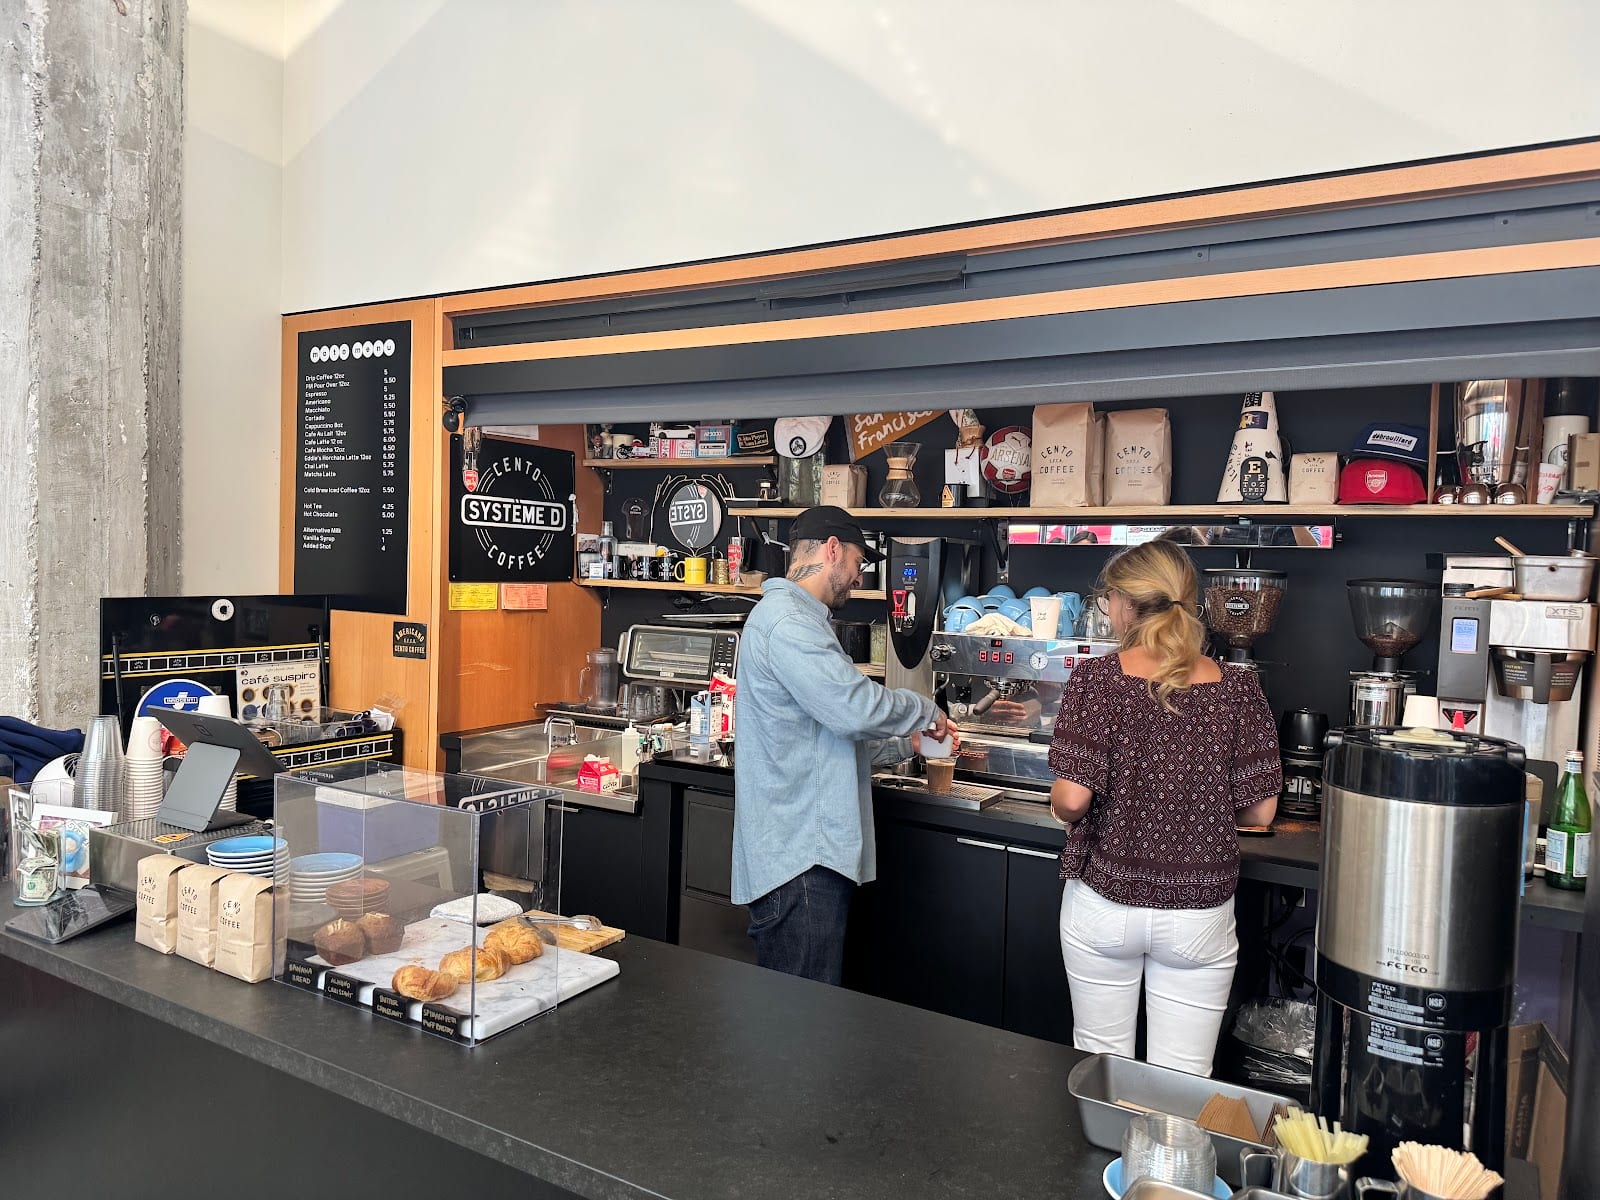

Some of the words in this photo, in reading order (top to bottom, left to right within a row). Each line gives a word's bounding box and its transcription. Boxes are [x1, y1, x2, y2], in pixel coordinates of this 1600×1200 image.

[352, 339, 395, 359] menu
[854, 410, 884, 433] San
[857, 410, 932, 450] Francisco
[991, 448, 1031, 467] ARSENA
[1040, 445, 1074, 459] CENTO
[1116, 446, 1151, 460] CENTO
[1303, 456, 1325, 465] CENTO
[493, 457, 541, 481] CENTO
[1040, 465, 1075, 474] COFFEE
[1248, 461, 1262, 474] E
[550, 508, 561, 526] D
[487, 544, 545, 570] COFFEE
[1551, 608, 1579, 616] XTS
[395, 627, 425, 642] AMERICANO
[241, 675, 269, 685] café
[273, 672, 316, 683] suspiro
[140, 876, 157, 890] CENTO
[138, 891, 155, 905] COFFEE
[181, 886, 198, 901] CENTO
[181, 902, 198, 915] COFFEE
[220, 916, 241, 929] COFFEE
[289, 963, 313, 975] BANANA
[292, 974, 311, 984] BREAD
[1371, 981, 1396, 991] FETCO
[1428, 997, 1443, 1007] NSF
[1370, 1021, 1396, 1031] FETCO
[1427, 1037, 1441, 1048] NSF
